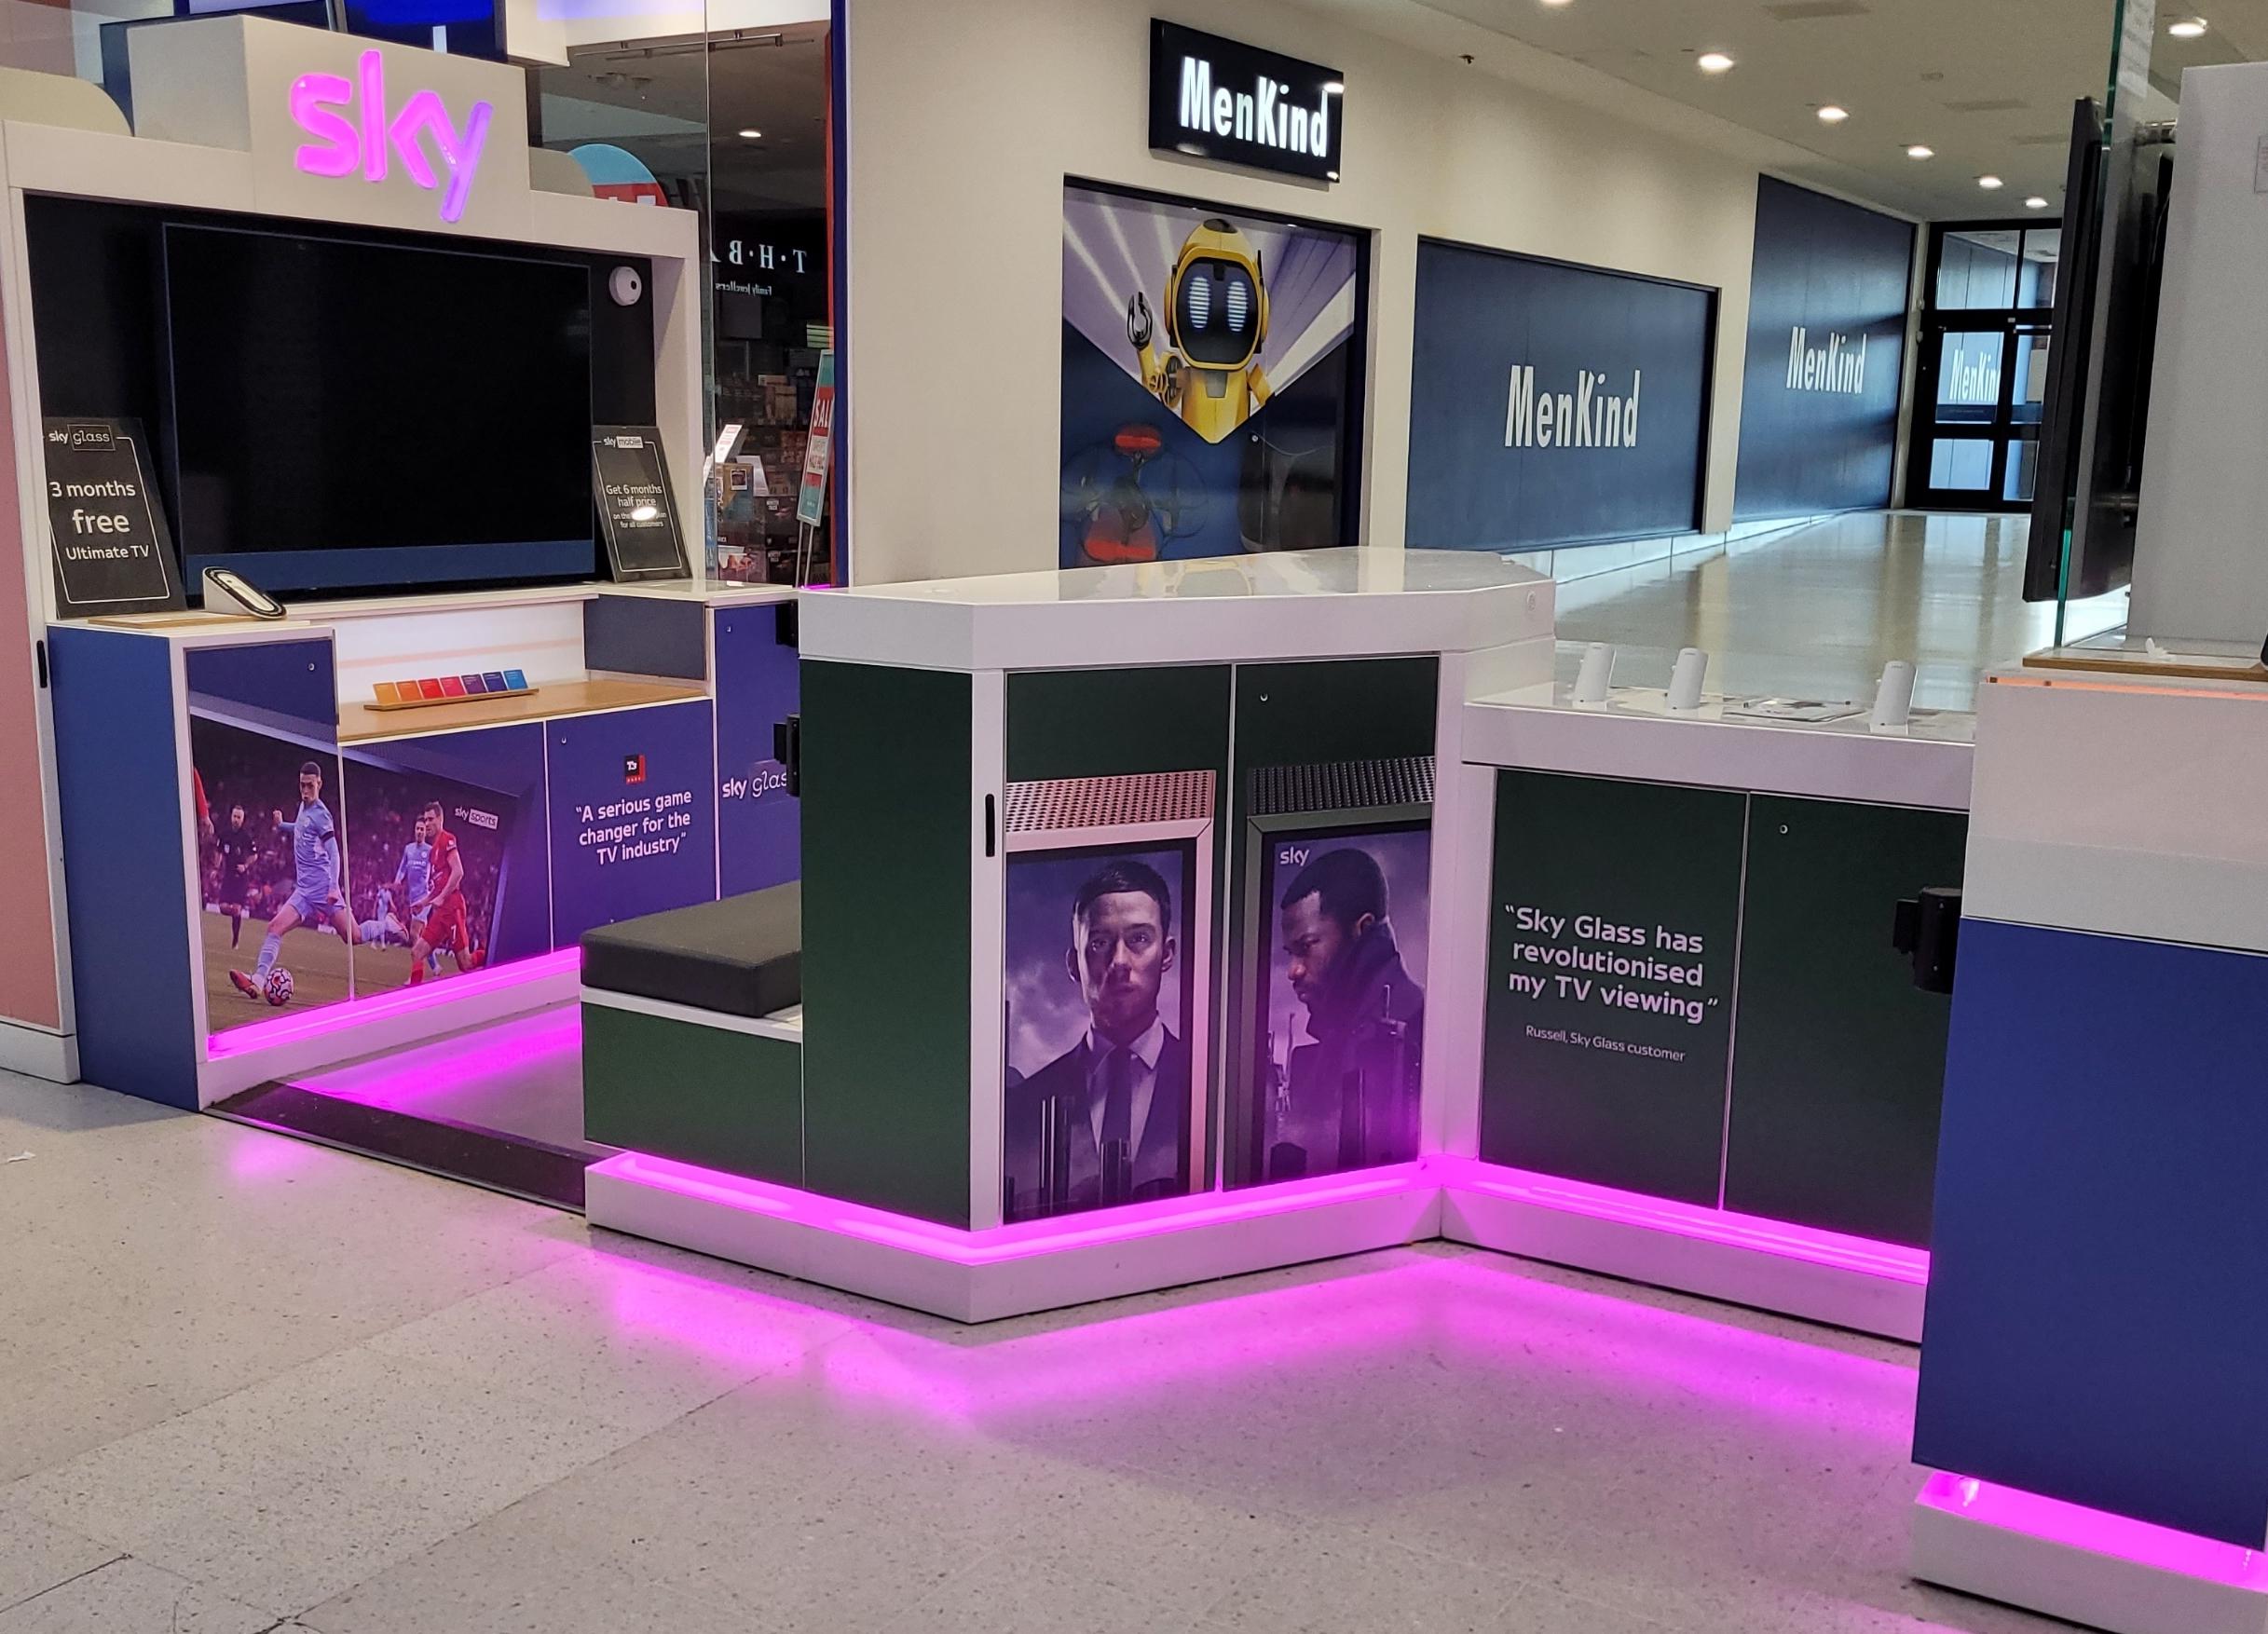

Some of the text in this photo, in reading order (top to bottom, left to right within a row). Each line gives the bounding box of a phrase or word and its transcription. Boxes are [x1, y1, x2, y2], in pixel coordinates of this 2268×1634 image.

[1180, 56, 1328, 157] MenKind
[289, 48, 493, 224] sky
[1786, 326, 1866, 394] MenKind
[813, 398, 832, 429] SAL
[1505, 365, 1640, 448] MenKind
[48, 430, 110, 444] sky glass
[604, 436, 616, 447] sky
[49, 481, 136, 497] 3 months
[606, 483, 663, 495] Get 6 months
[618, 496, 656, 508] half price
[72, 509, 130, 534] free
[65, 544, 149, 560] Ultimate TV
[722, 769, 787, 799] sky glas
[455, 807, 496, 826] sky sports
[598, 797, 650, 821] serious
[655, 791, 691, 813] game
[579, 812, 690, 846] changer for the
[596, 846, 618, 865] TV
[1280, 846, 1309, 866] sky
[1574, 915, 1646, 946] Glass
[1656, 925, 1703, 954] has
[1512, 941, 1703, 987] revolutionised
[1509, 973, 1546, 1000] my
[1554, 974, 1592, 1001] TV
[1525, 1025, 1686, 1062] Russell, Sky Glass customer
